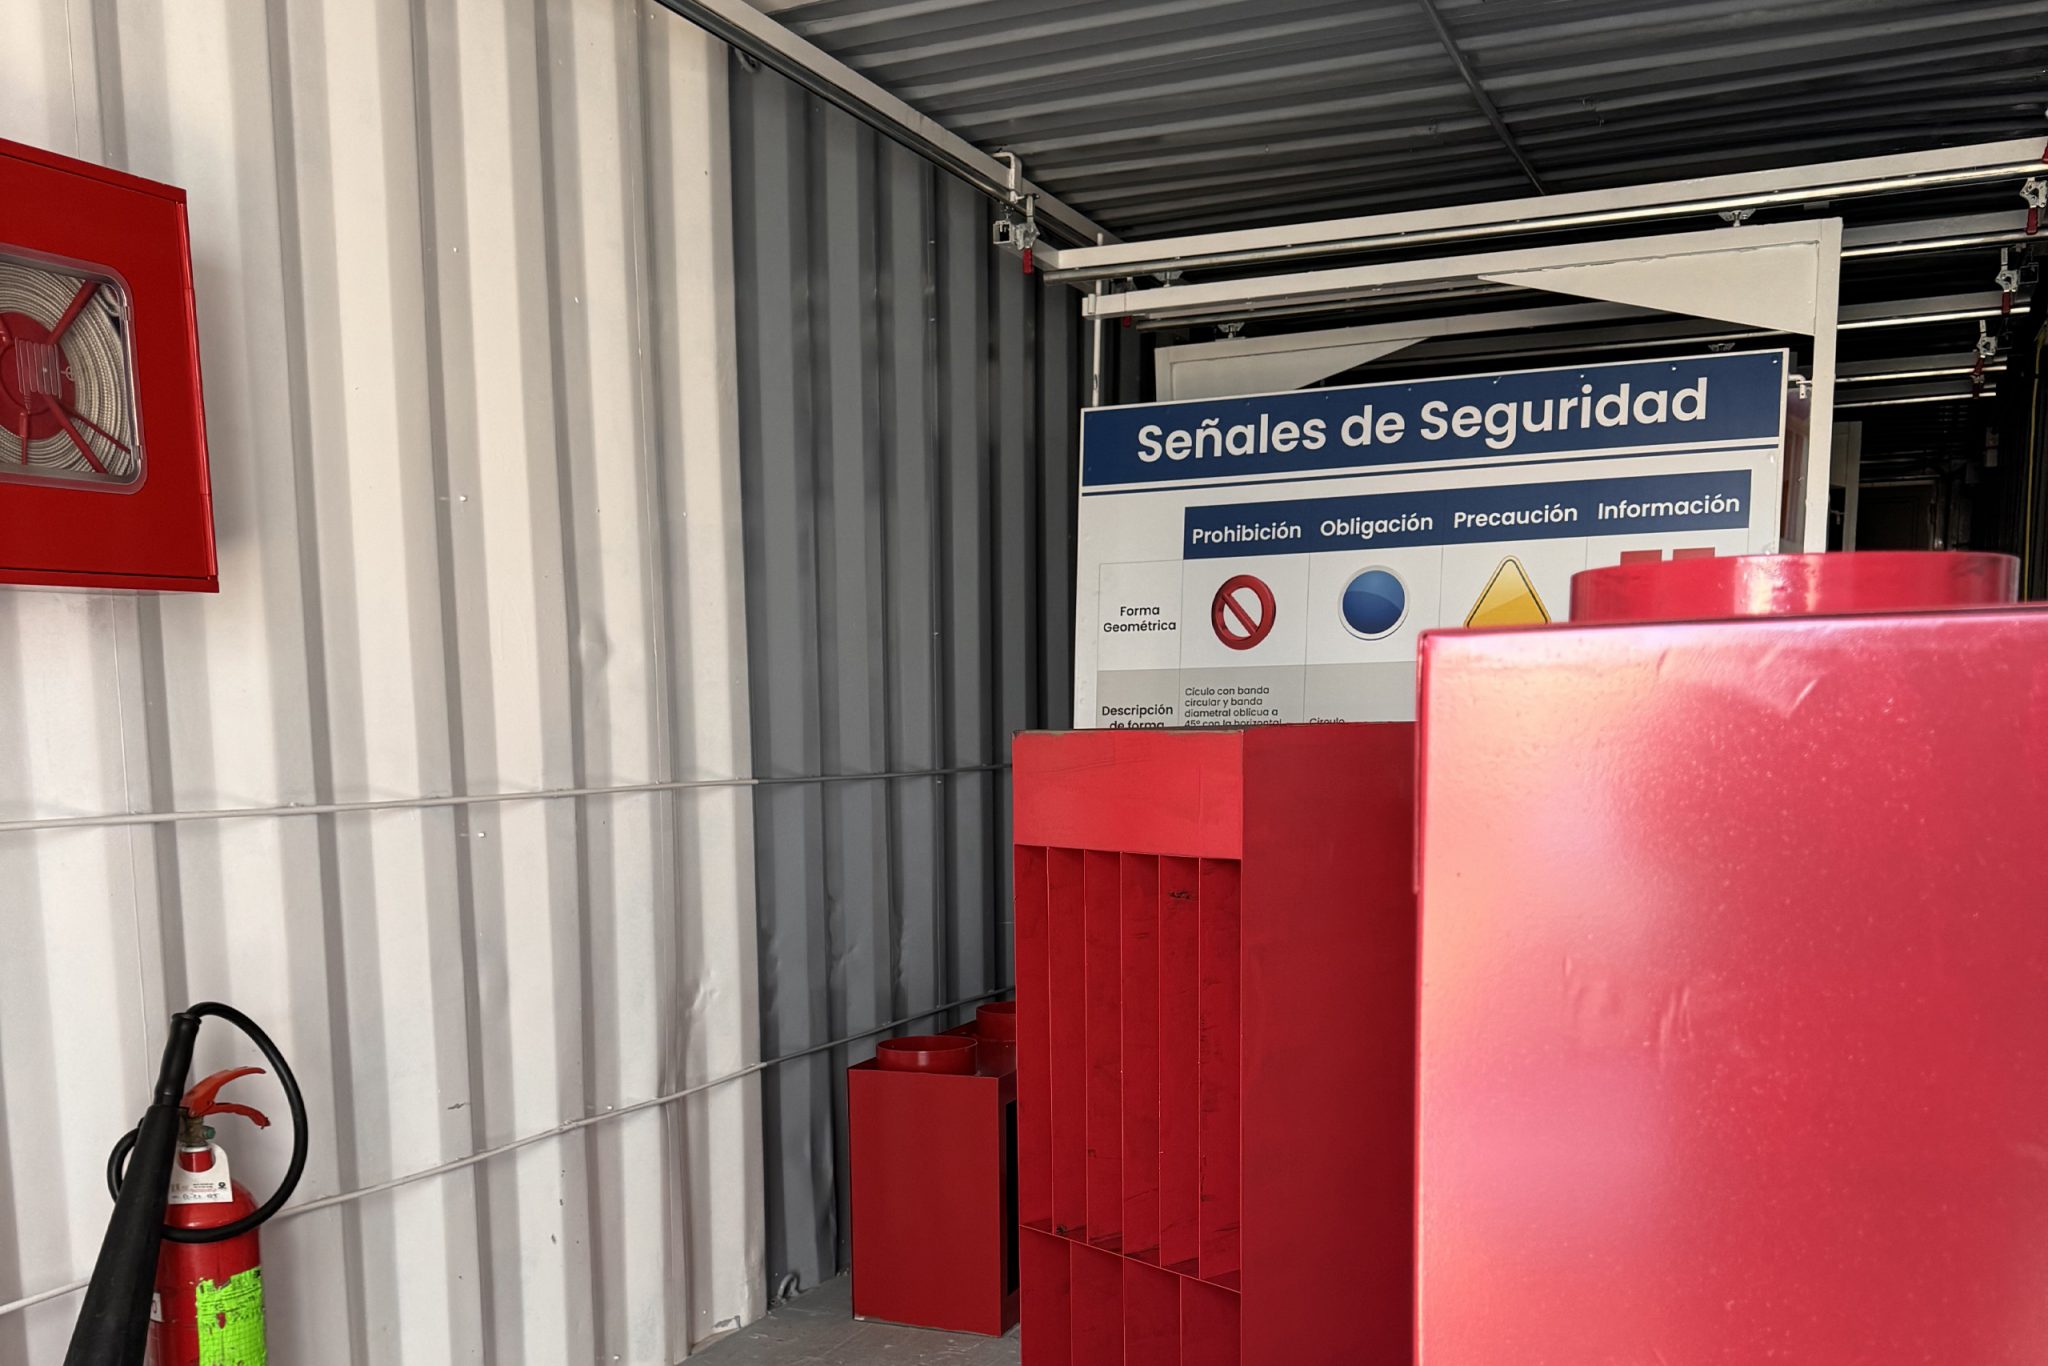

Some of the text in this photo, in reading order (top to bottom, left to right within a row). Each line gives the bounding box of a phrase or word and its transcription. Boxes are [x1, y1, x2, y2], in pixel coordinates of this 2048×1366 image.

[1138, 377, 1708, 462] Señales de Seguridad
[1597, 494, 1740, 520] Información
[1453, 504, 1578, 529] Precaución
[1192, 521, 1302, 545] Prohibición
[1320, 513, 1433, 540] Obligación
[1120, 606, 1160, 616] Forma
[1103, 620, 1176, 632] Geométrica
[1217, 687, 1235, 695] con
[1237, 686, 1270, 695] banda
[1184, 697, 1263, 708] circular y banda
[1102, 704, 1173, 718] Descripción
[1184, 708, 1231, 718] diametral
[1109, 720, 1125, 729] de
